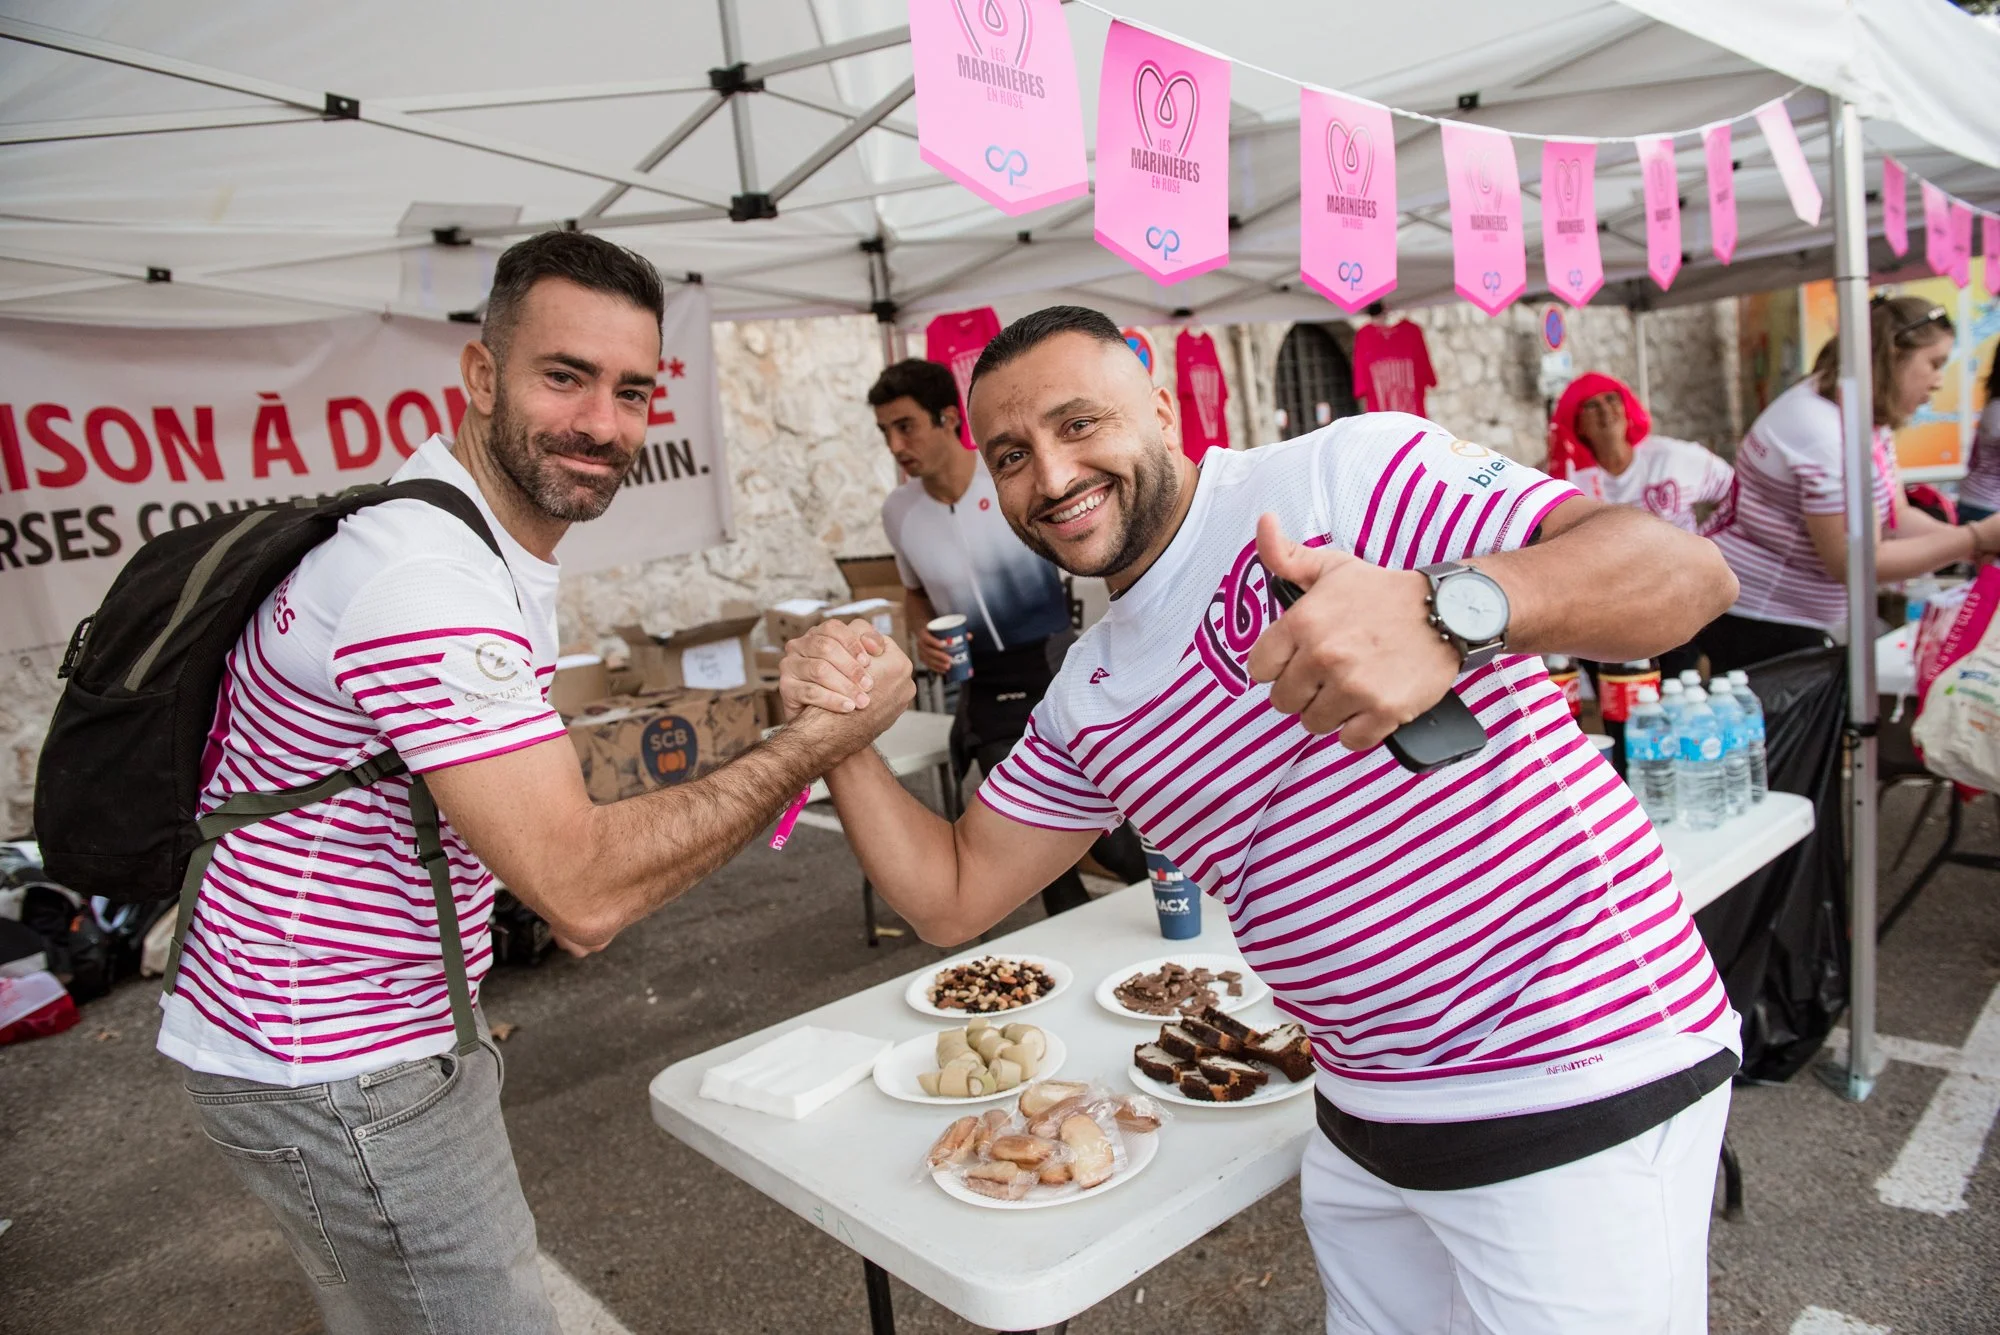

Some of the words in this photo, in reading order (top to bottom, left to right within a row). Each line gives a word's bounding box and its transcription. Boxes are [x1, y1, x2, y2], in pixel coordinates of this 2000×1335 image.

[991, 46, 1006, 63] LES
[957, 53, 1045, 99] MARINIÈRES
[986, 86, 998, 102] EN
[1160, 138, 1171, 153] LES
[1131, 147, 1200, 183] MARINIÈRES
[1152, 175, 1160, 189] EN
[254, 391, 310, 478] À
[650, 728, 688, 751] SCB
[1545, 1054, 1604, 1075] INFINITECH
